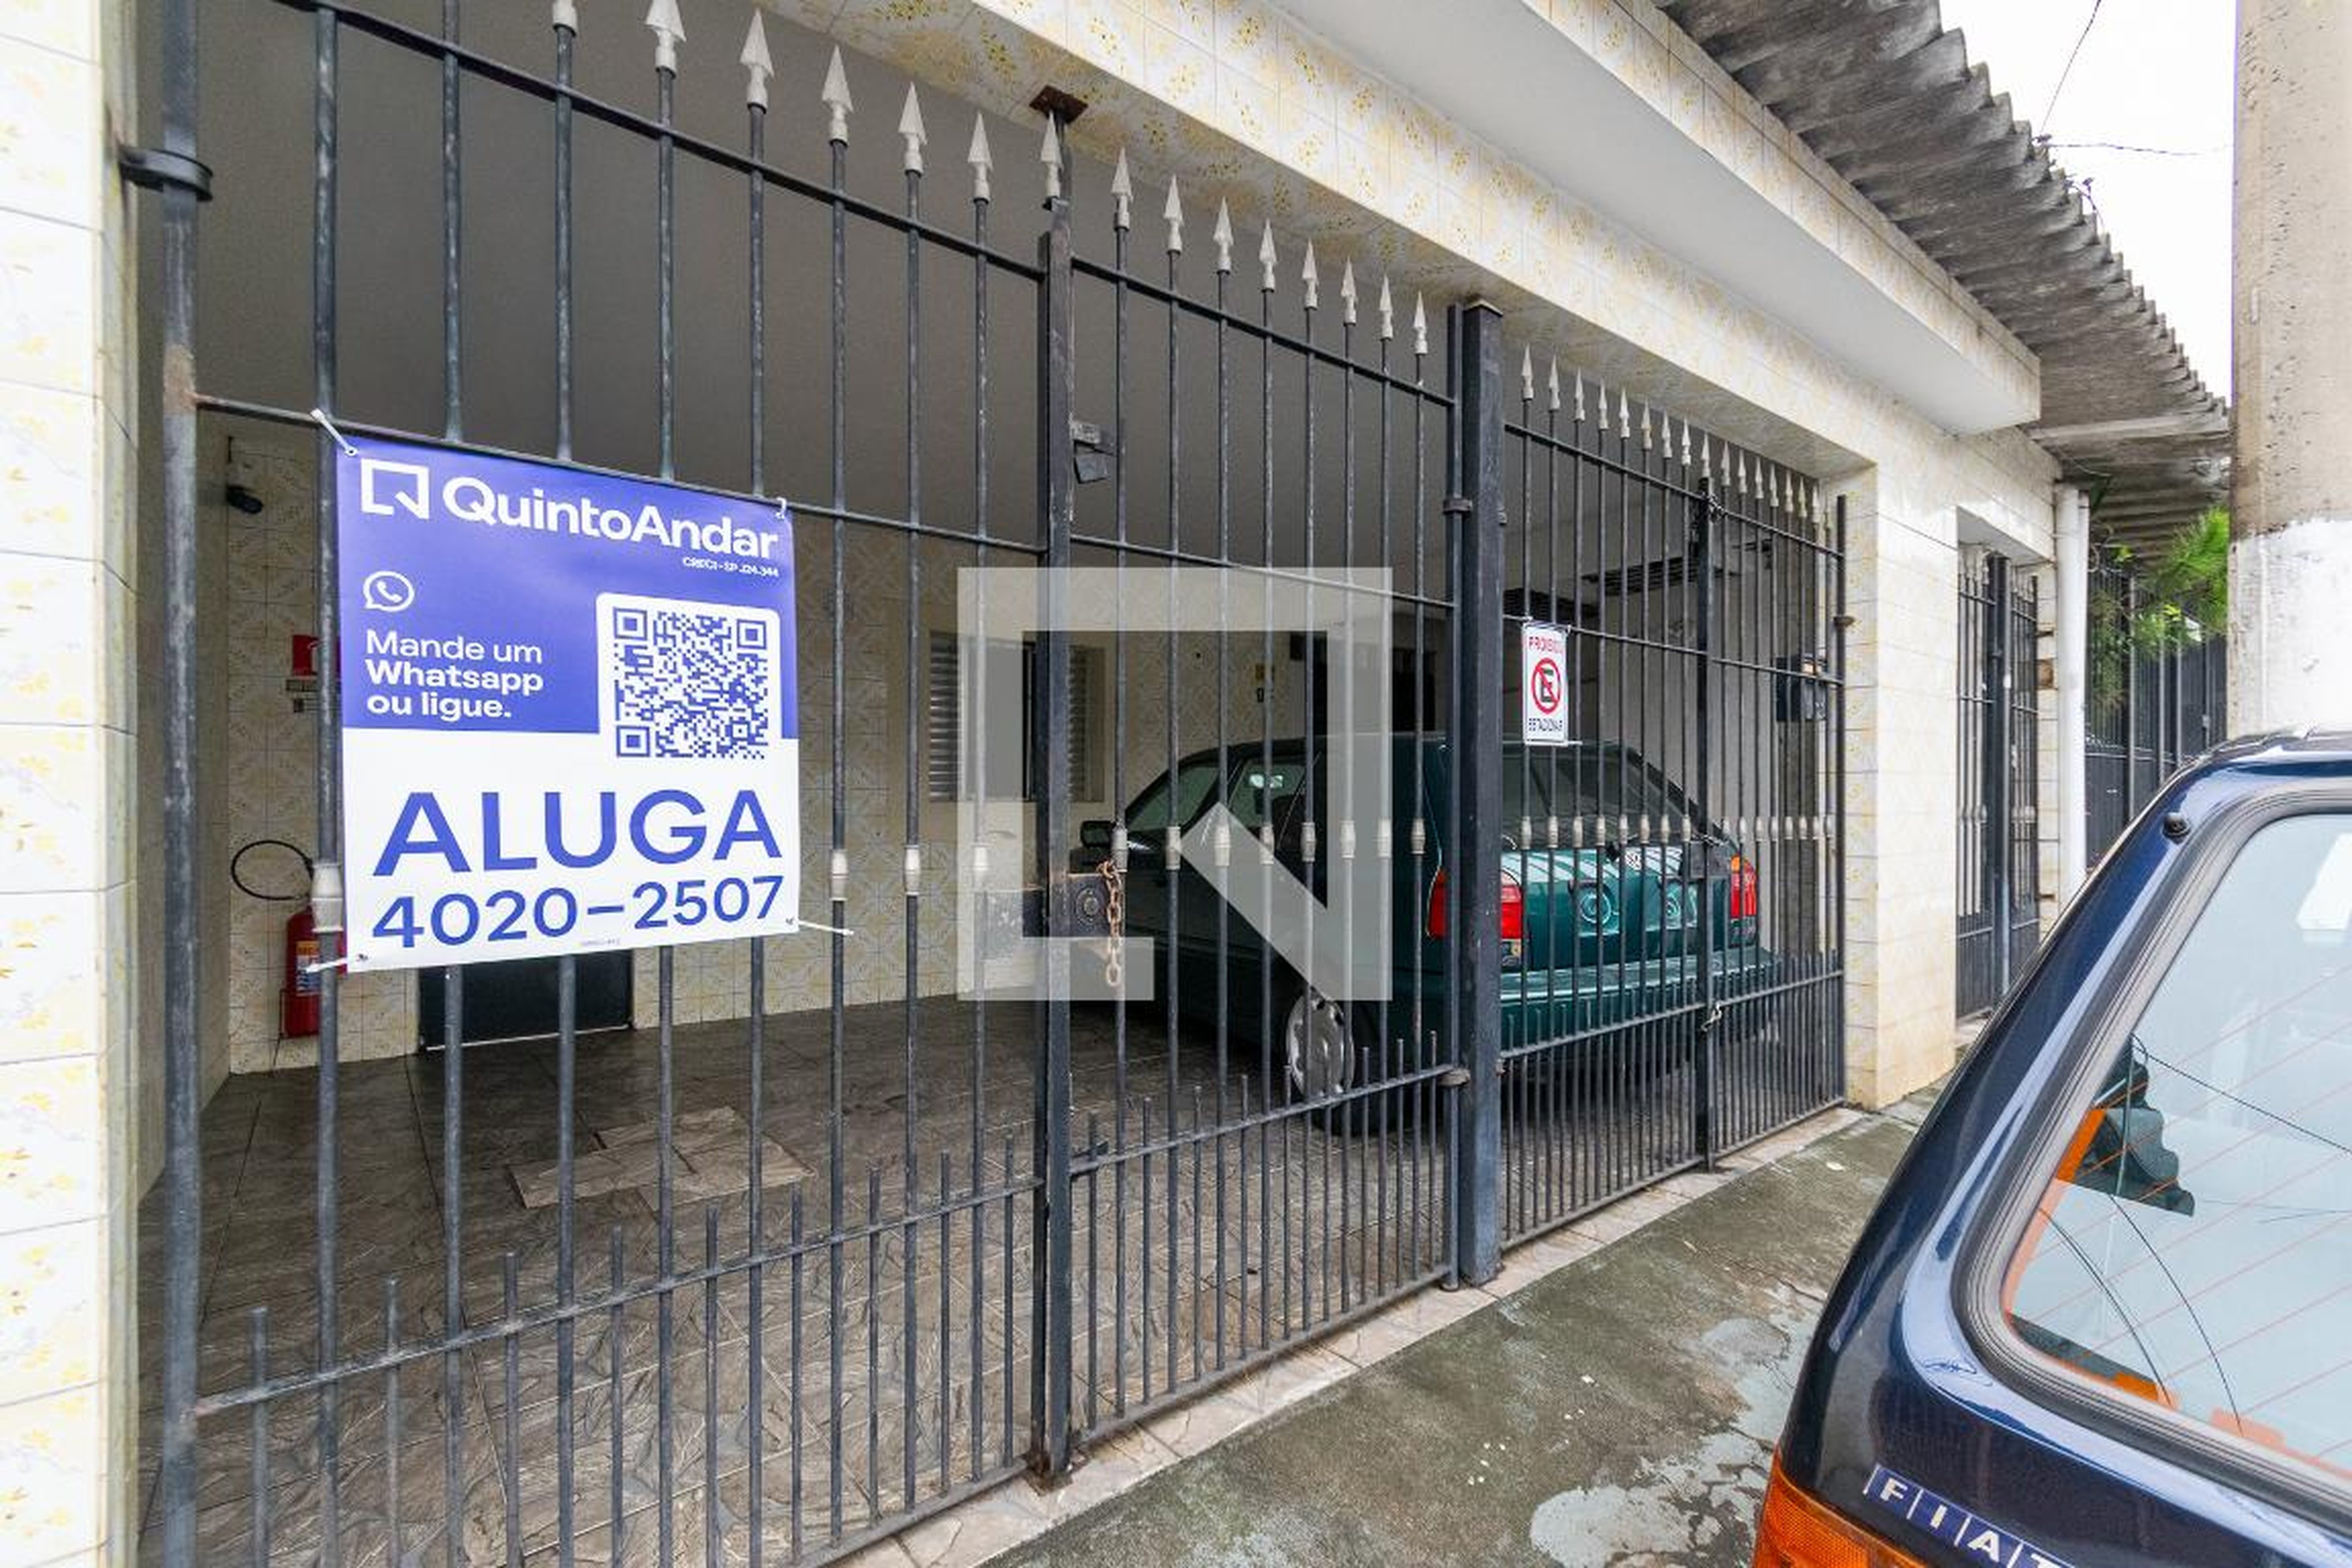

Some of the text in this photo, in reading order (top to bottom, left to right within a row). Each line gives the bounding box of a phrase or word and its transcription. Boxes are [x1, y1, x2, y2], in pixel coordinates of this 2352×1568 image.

[442, 475, 779, 559] QuintoAndar
[366, 628, 543, 664] Mande um
[365, 658, 543, 696] Whatsapp
[367, 691, 511, 723] ou ligue.
[372, 789, 783, 876] ALUGA
[372, 875, 785, 948] 4020-2507
